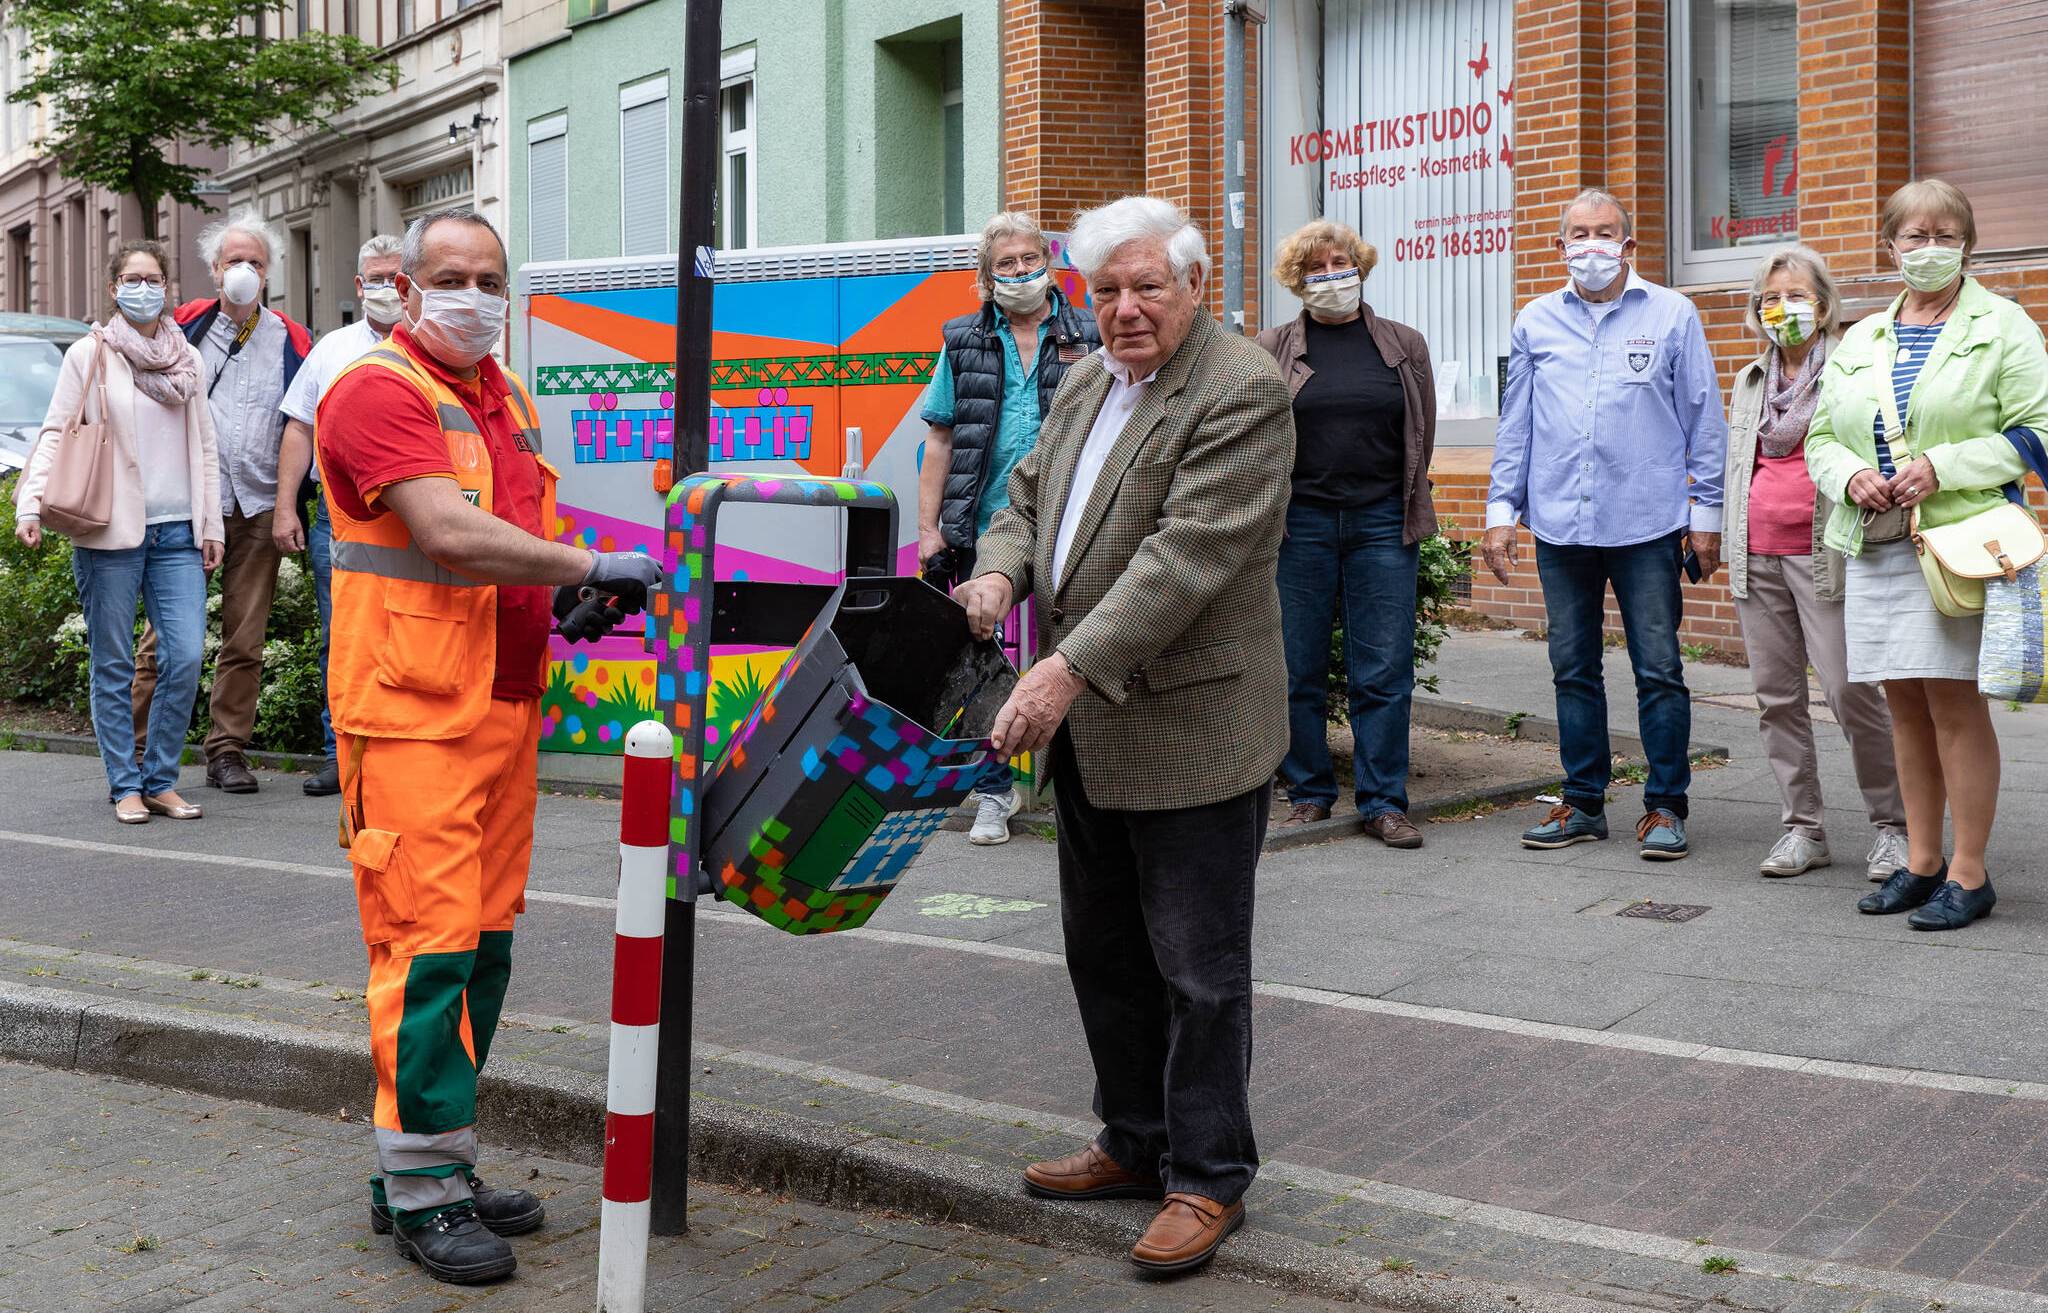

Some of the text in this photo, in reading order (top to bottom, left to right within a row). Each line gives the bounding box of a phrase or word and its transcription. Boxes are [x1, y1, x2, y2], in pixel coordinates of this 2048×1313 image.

[1290, 101, 1493, 166] KOSMETIKSTUDIO
[1330, 163, 1406, 192] Fusspflege
[1420, 148, 1493, 179] Kosmetik
[1415, 217, 1440, 229] termin
[1711, 207, 1797, 241] Kosmeti
[1395, 226, 1515, 262] 0162 1863307
